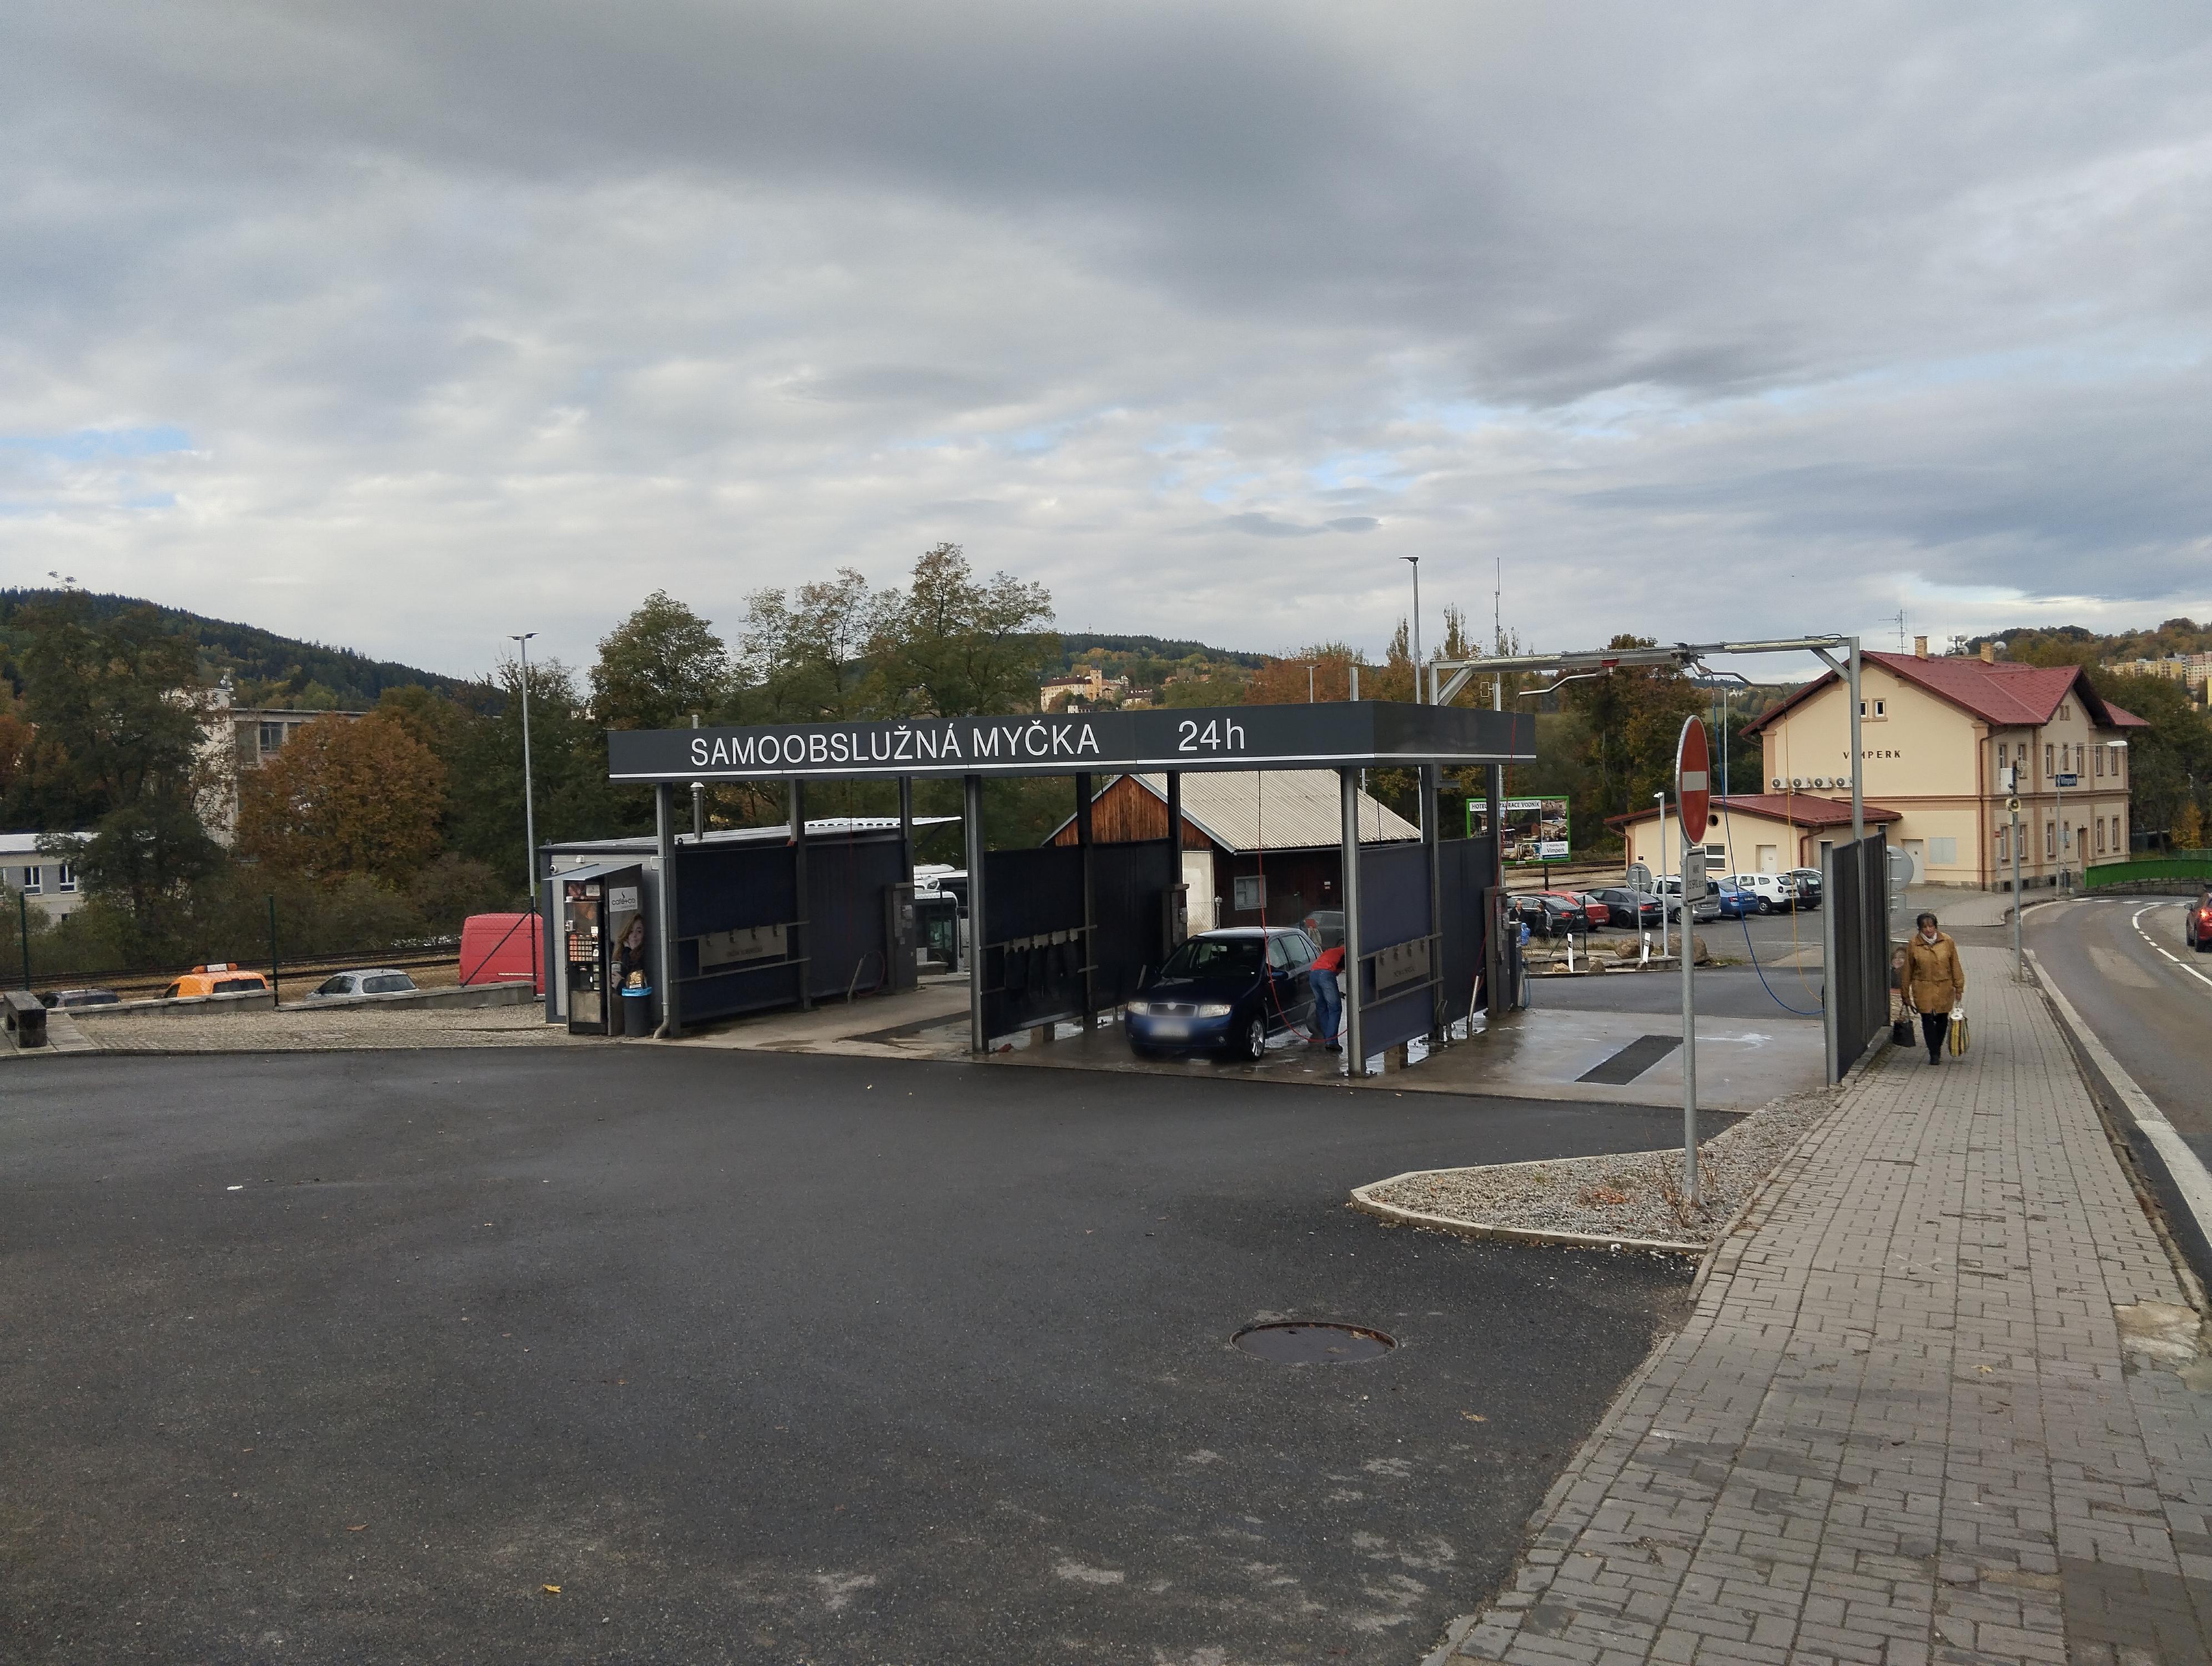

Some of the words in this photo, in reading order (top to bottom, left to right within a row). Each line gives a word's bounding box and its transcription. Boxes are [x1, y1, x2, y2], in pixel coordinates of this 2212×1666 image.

[691, 723, 962, 766] SAMOOBSLUŽNÁ
[973, 720, 1100, 757] MYČKA
[1178, 718, 1245, 751] 24h
[1842, 750, 1901, 759] VMPERK
